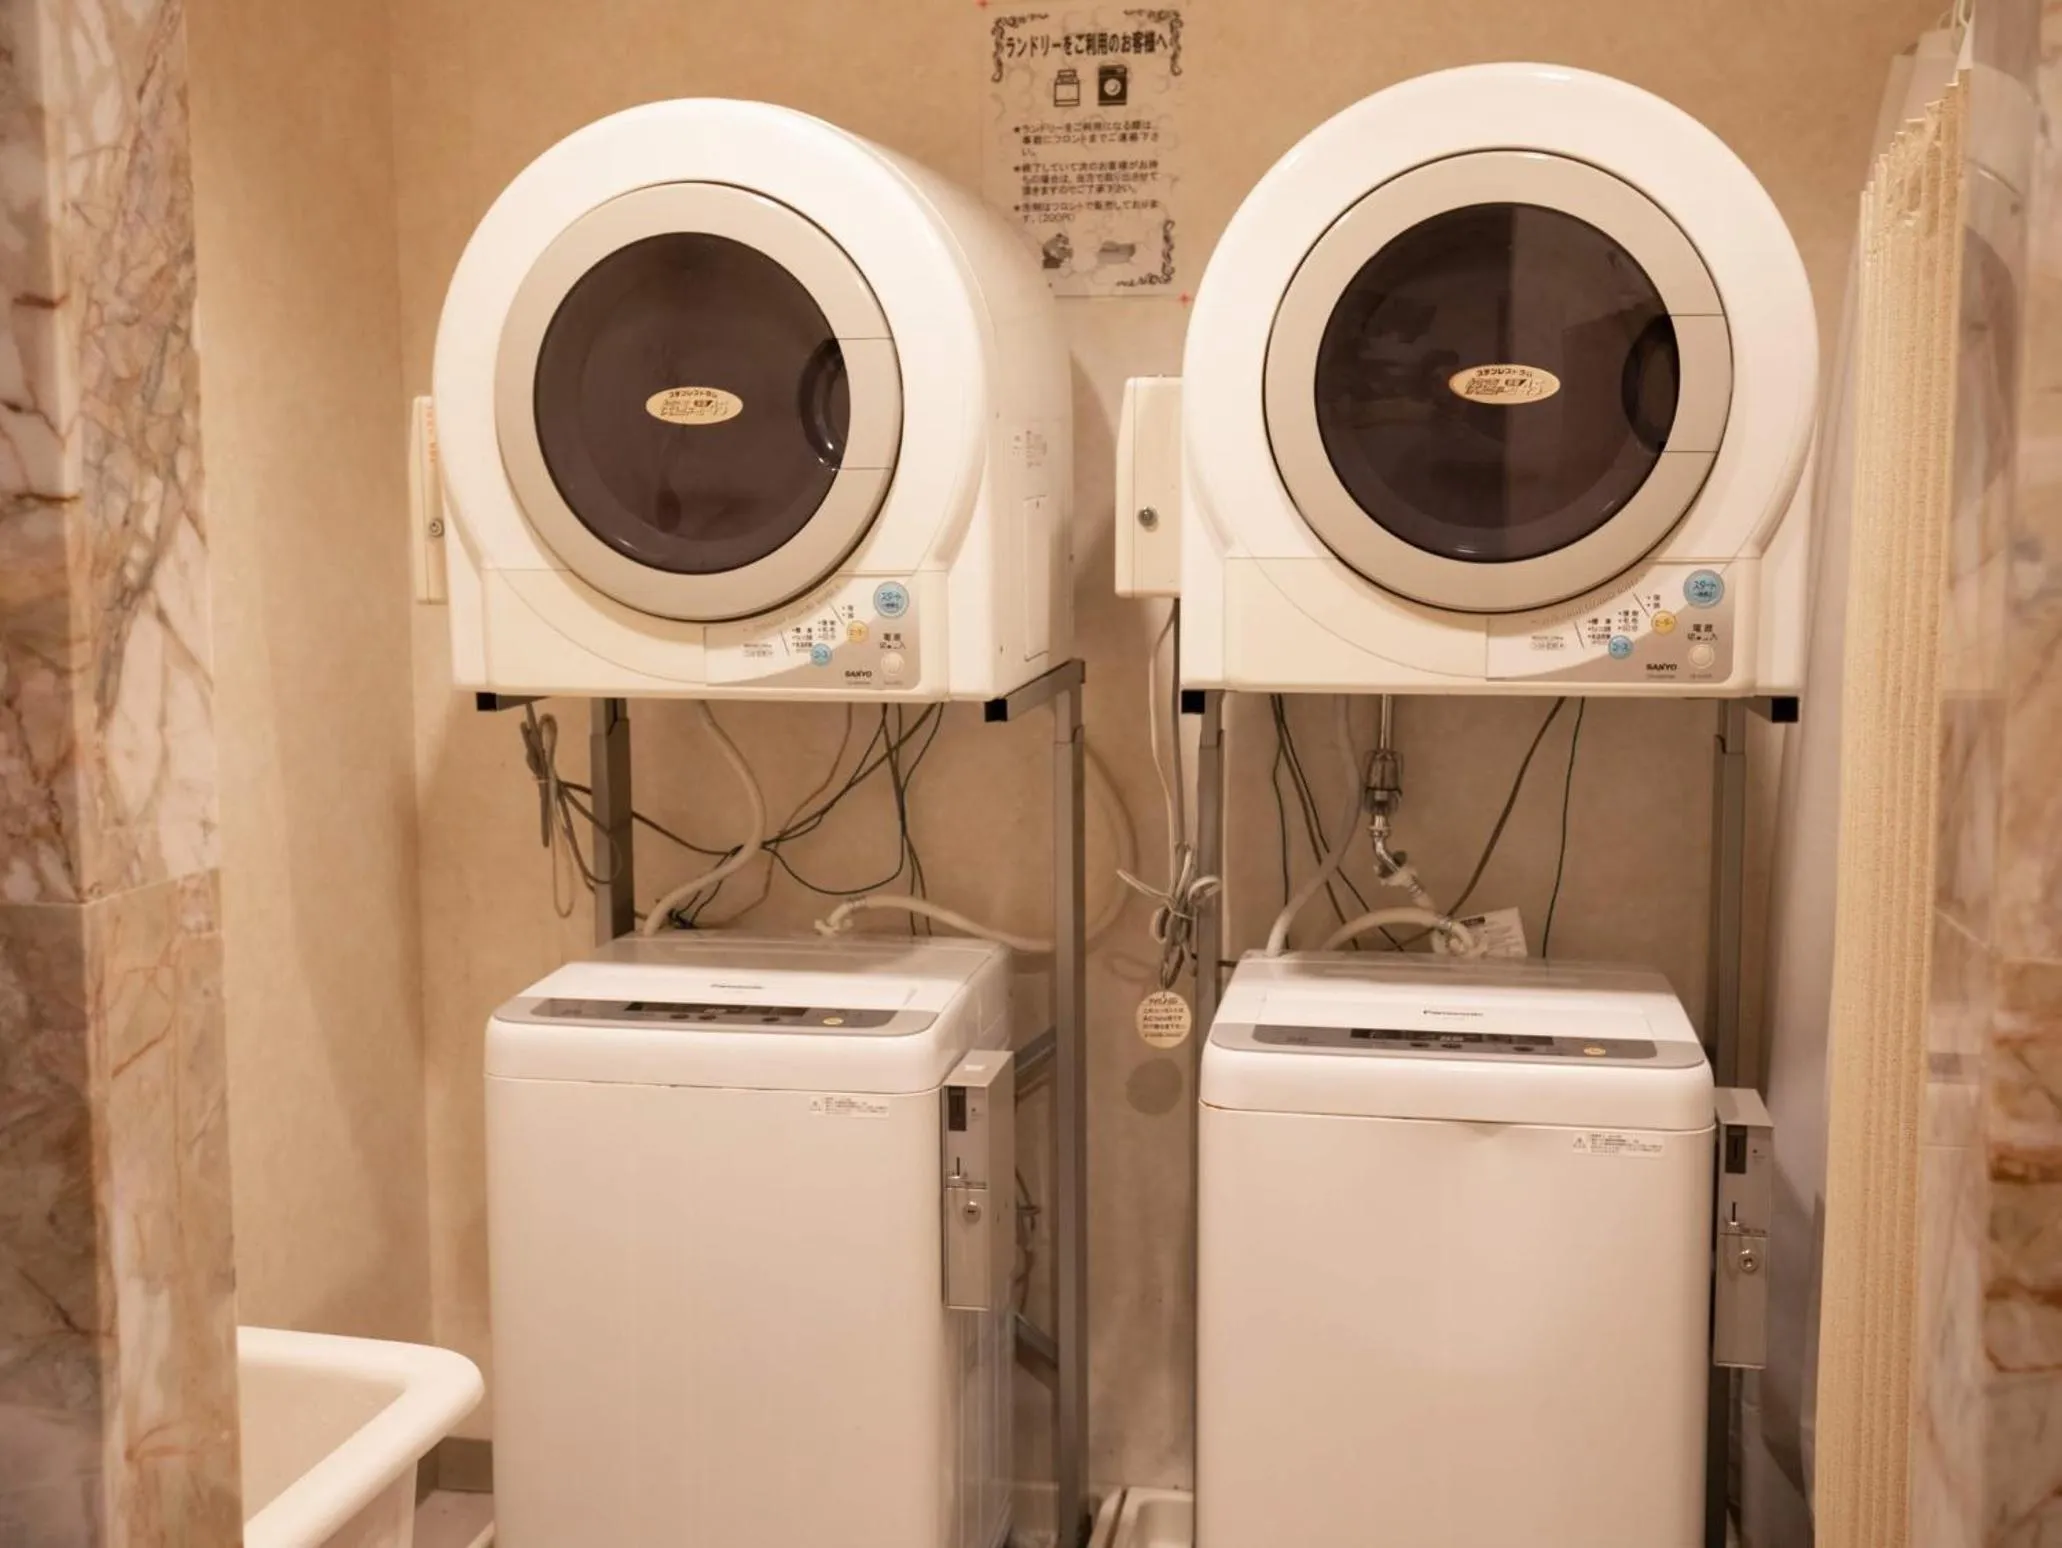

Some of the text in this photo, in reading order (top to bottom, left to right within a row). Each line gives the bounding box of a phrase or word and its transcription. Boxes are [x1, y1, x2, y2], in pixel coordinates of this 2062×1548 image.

[1004, 31, 1169, 58] ランドリーをご利用のお客様へ
[1645, 663, 1678, 671] SANYO
[844, 670, 873, 678] SANYO
